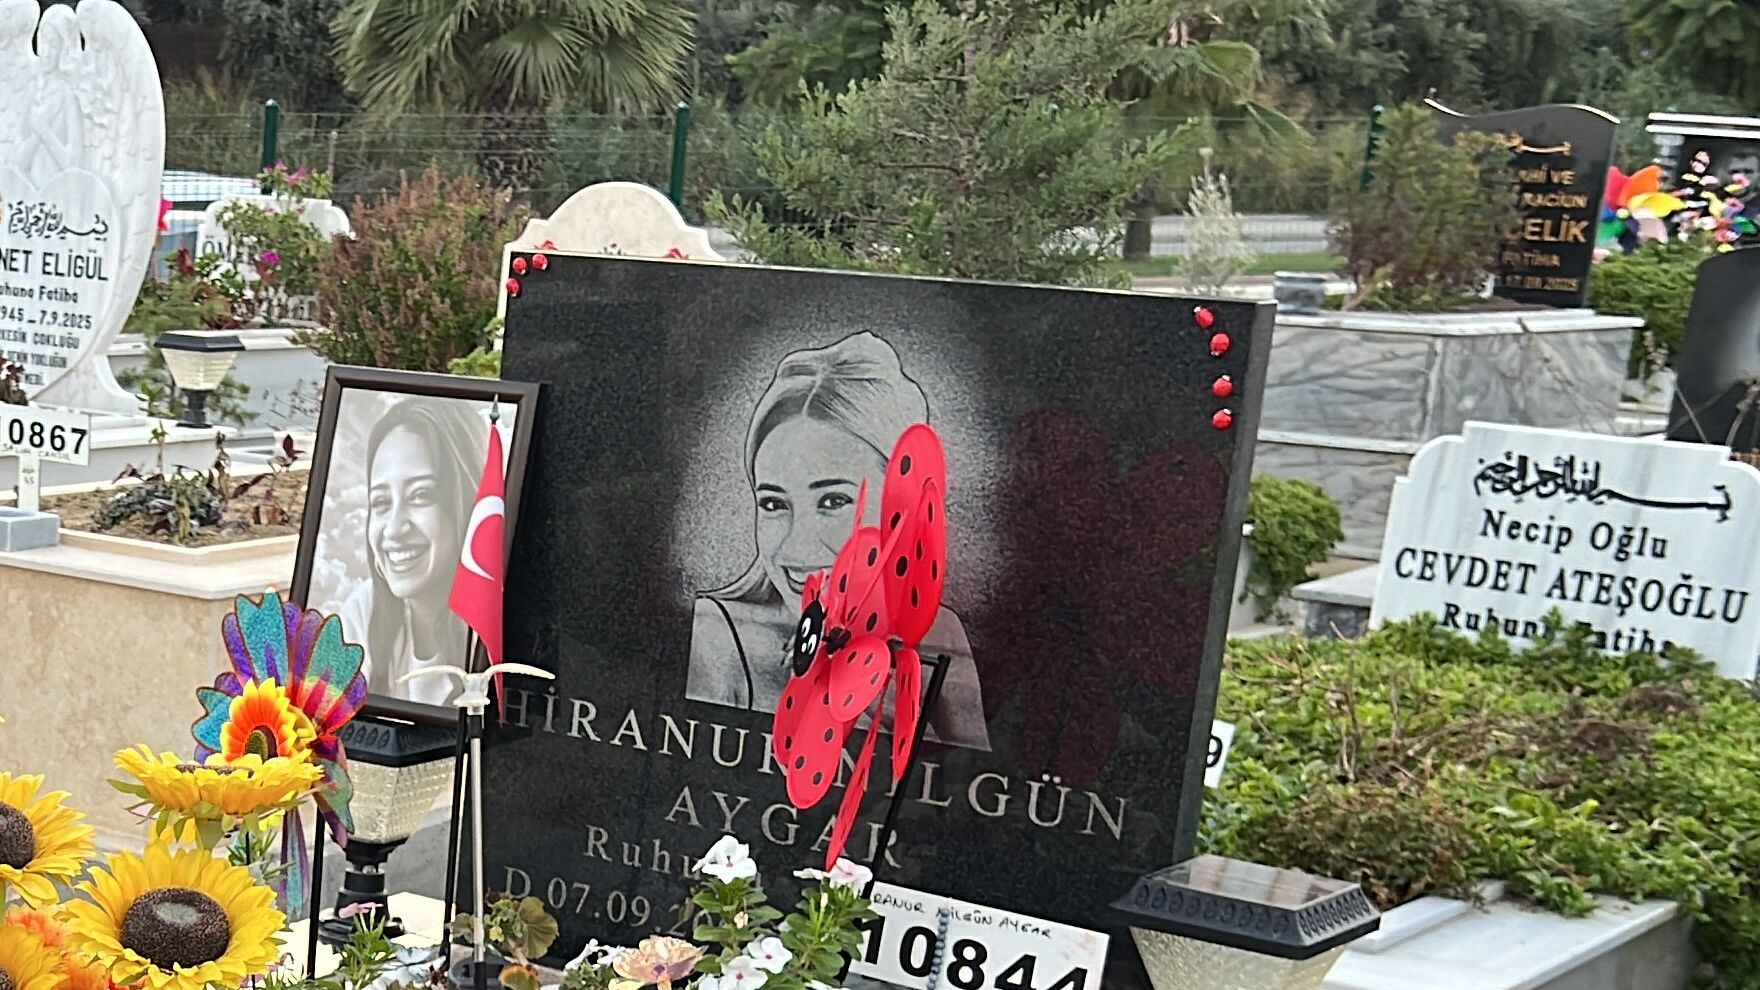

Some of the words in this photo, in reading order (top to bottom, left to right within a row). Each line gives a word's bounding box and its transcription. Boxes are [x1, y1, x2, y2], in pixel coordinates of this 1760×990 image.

[41, 248, 109, 282] ELİGÜL
[39, 286, 79, 304] Fatiha
[39, 311, 92, 330] 7.9.2025
[1479, 507, 1574, 555] Necip
[1590, 520, 1670, 563] Oğlu
[1394, 545, 1538, 596] CEVDET
[1544, 566, 1751, 625] ATEŞOĞLU
[1442, 602, 1548, 640] Ruhun
[582, 824, 702, 881] Ruhu
